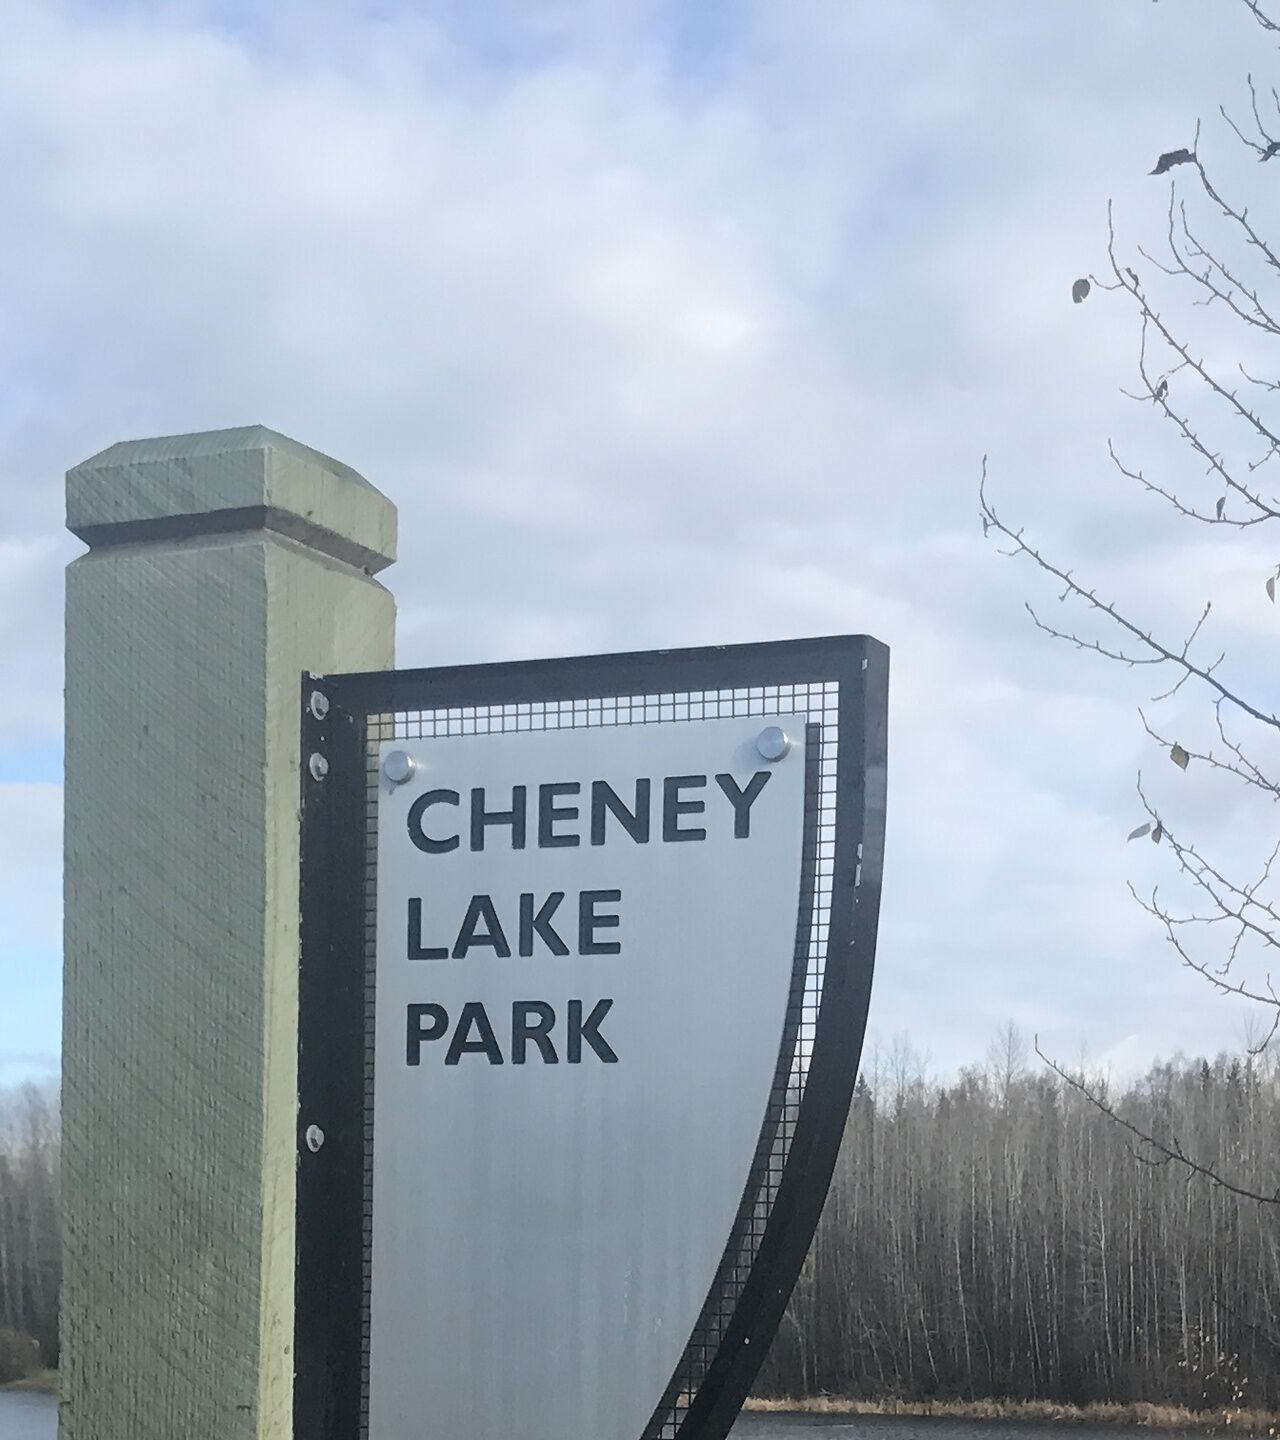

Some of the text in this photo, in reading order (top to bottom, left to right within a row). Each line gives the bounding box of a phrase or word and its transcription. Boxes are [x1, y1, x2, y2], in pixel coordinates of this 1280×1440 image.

[407, 771, 772, 855] CHENEY
[407, 889, 622, 961] LAKE
[406, 998, 619, 1066] PARK
